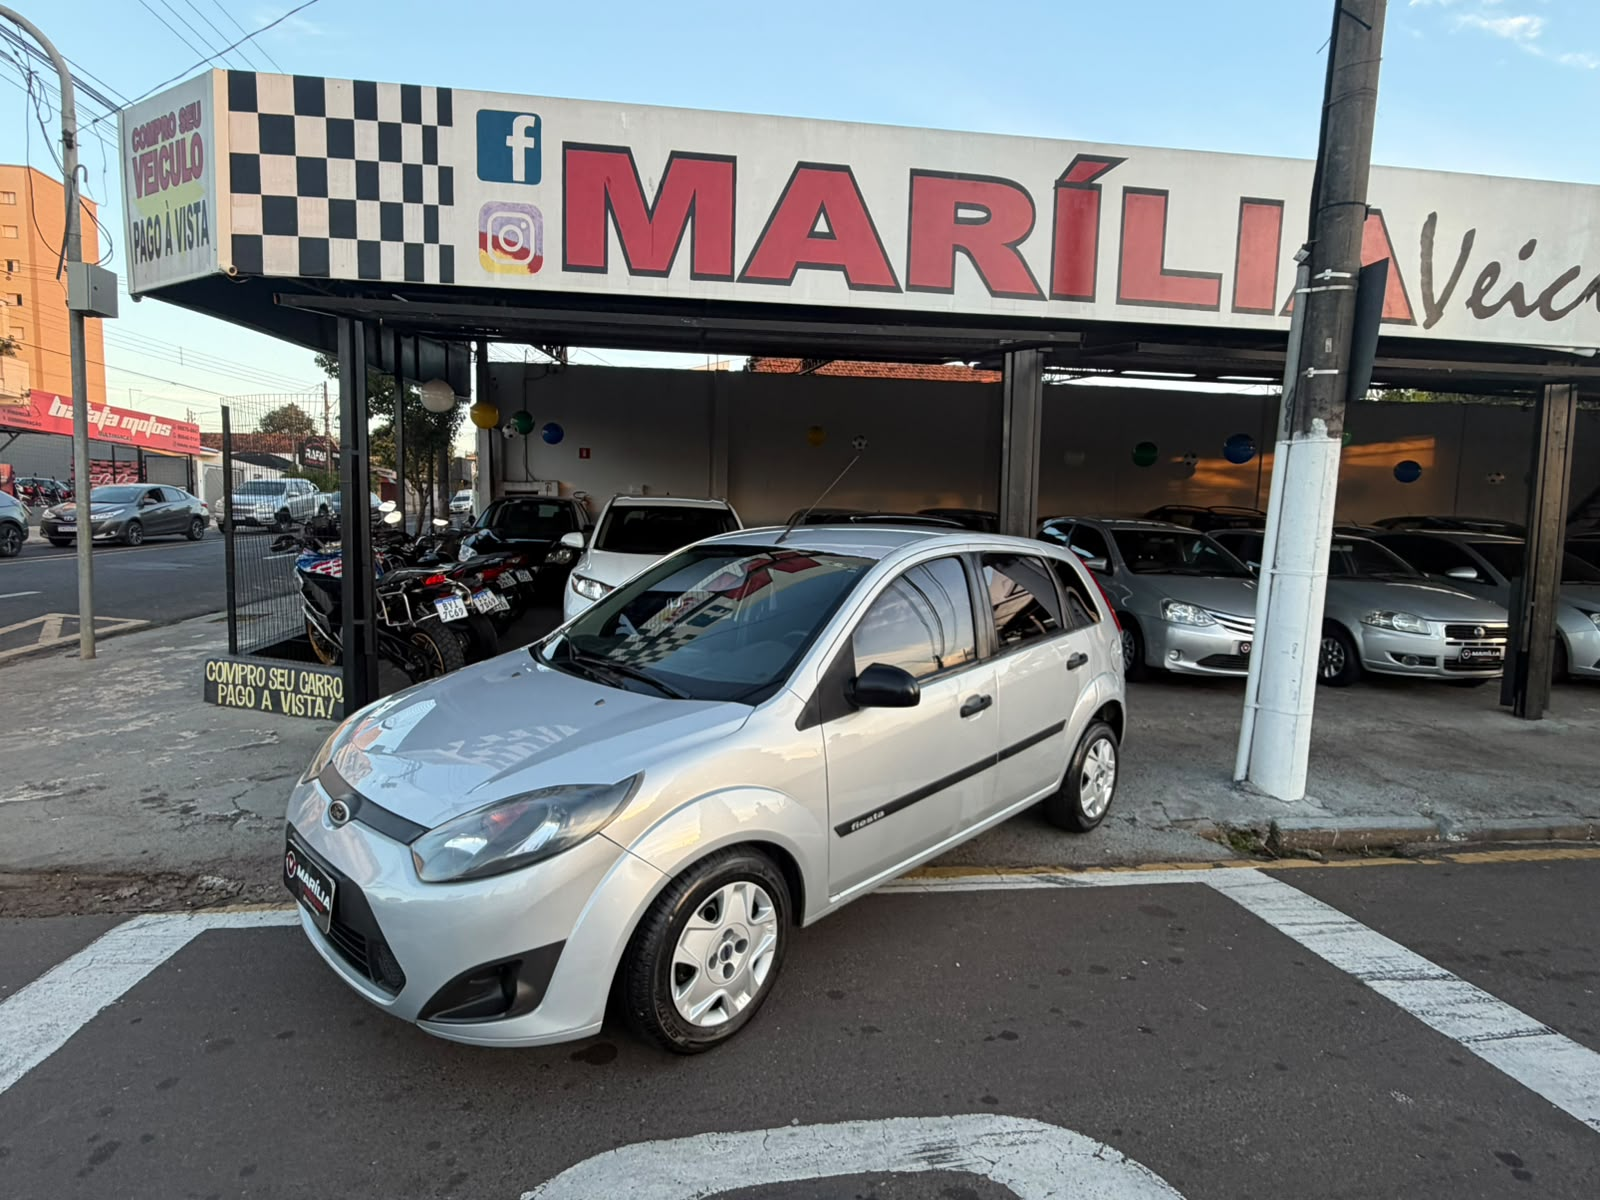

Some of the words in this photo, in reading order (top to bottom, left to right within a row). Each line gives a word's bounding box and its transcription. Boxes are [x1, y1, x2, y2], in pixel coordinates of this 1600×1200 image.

[132, 111, 177, 153] COMPRO
[178, 100, 202, 135] SEU
[132, 132, 204, 199] VEICULO
[133, 213, 161, 264] PAGO
[165, 200, 173, 257] À
[174, 200, 209, 253] VISTA
[1420, 211, 1600, 330] Veic
[206, 661, 266, 687] COMPRO
[269, 667, 295, 691] SEU
[217, 683, 255, 708] PAGO
[261, 690, 272, 711] A
[280, 691, 335, 719] VISTA!
[297, 864, 330, 911] MARÍLIA
